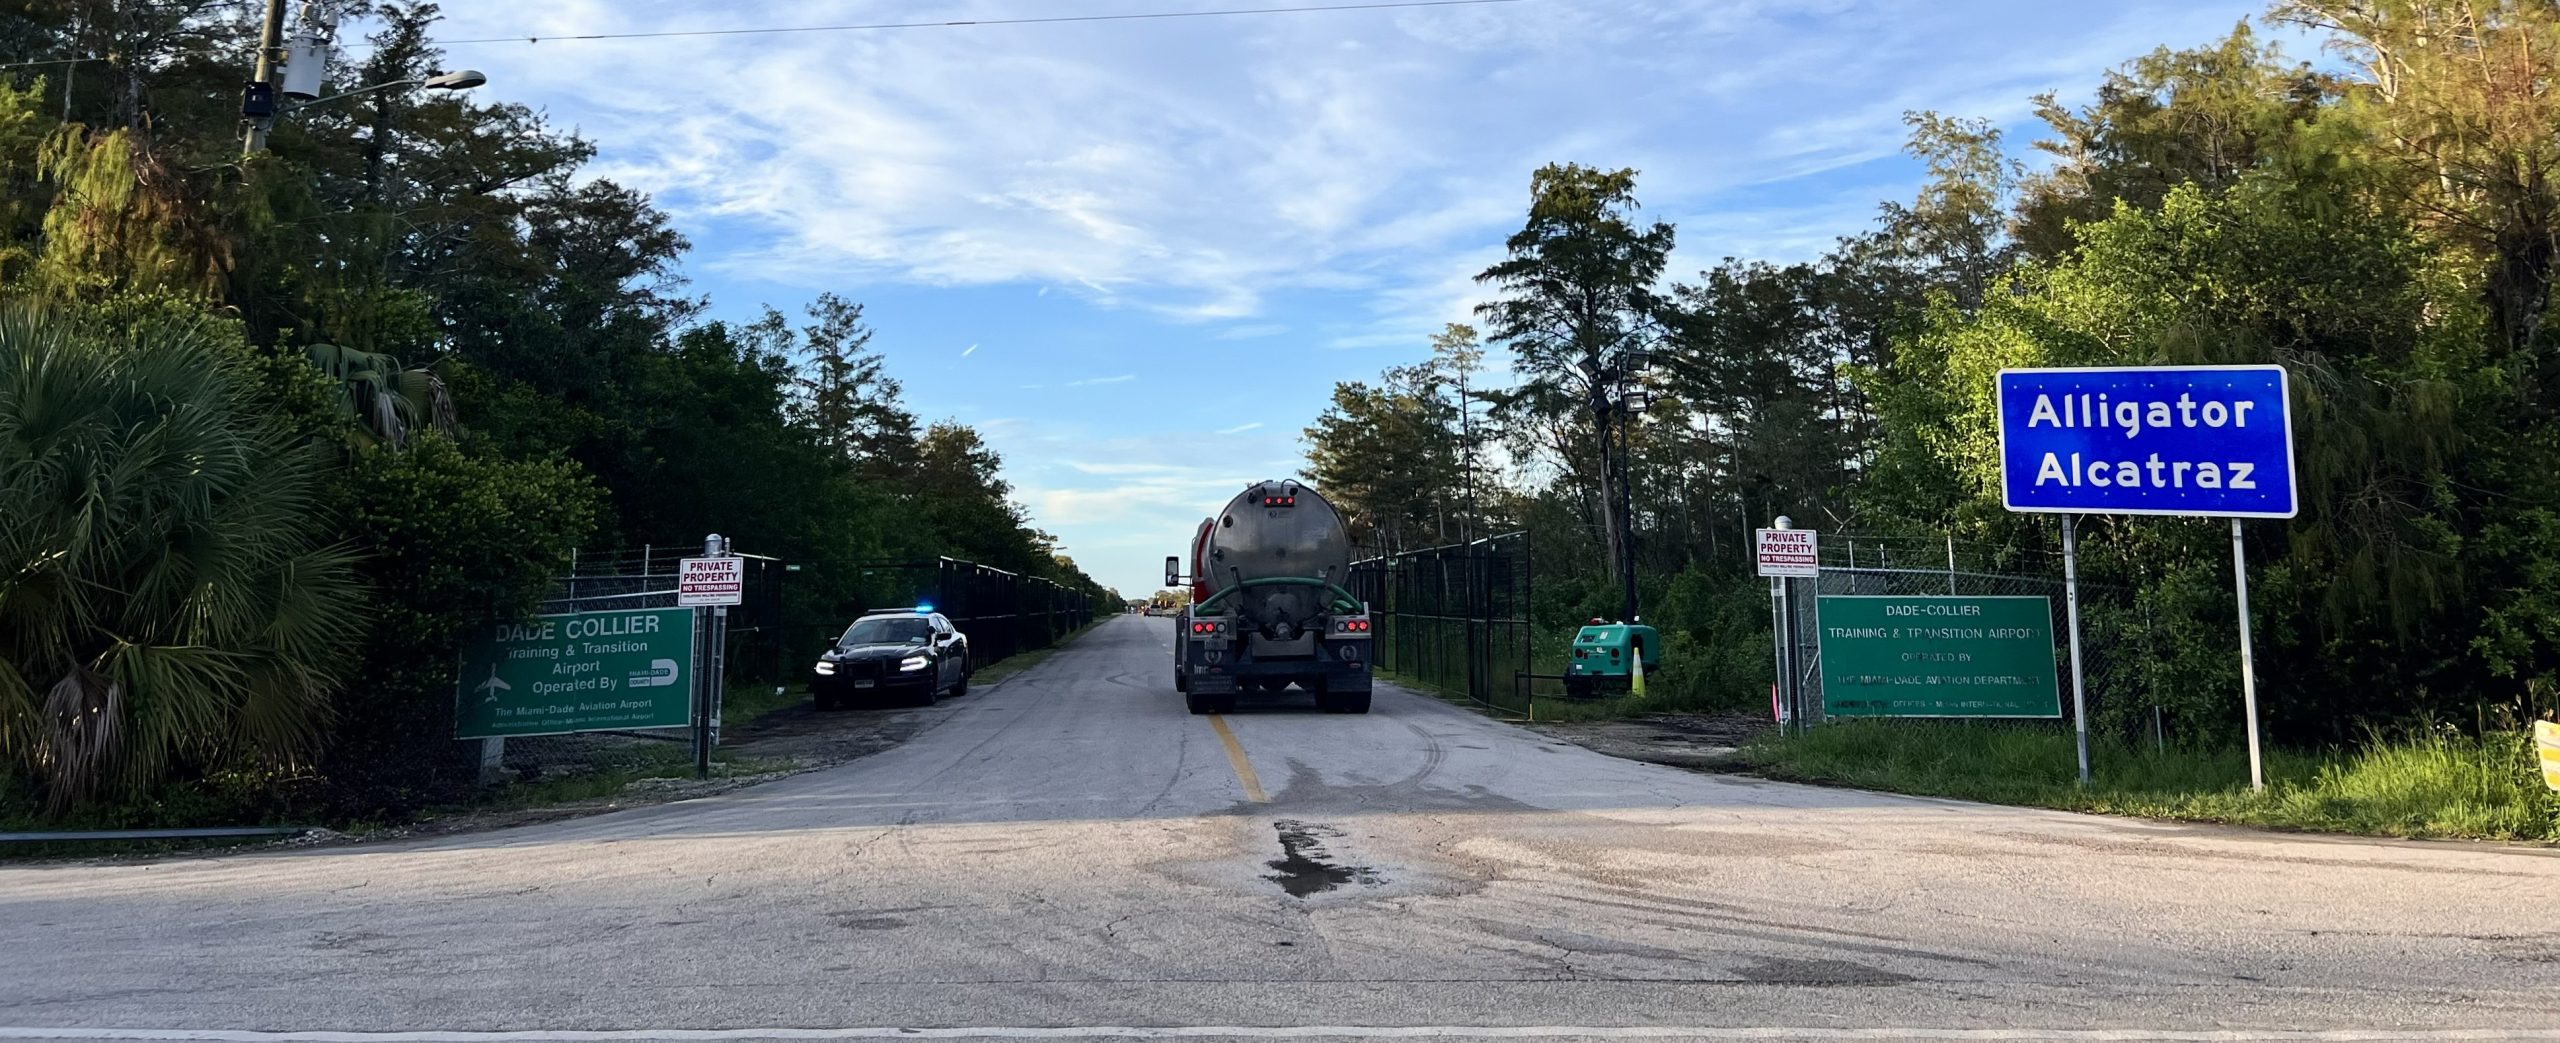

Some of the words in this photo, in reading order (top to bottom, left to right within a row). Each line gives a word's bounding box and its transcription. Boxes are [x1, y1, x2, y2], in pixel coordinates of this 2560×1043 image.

[2028, 392, 2254, 439] Alligator
[2035, 452, 2257, 489] Alcatraz
[1766, 533, 1807, 543] PRIVATE
[1761, 544, 1812, 553] PROPERTY
[690, 562, 733, 571] PRIVATE
[683, 572, 738, 582] PROPERTY
[1886, 605, 1981, 616] DADE-COLLIER
[496, 622, 555, 643] DADE
[566, 615, 660, 639] COLLIER
[1828, 627, 1887, 639] TRAINING
[1893, 628, 1901, 639] &
[505, 646, 559, 660] Training
[565, 645, 575, 656] &
[583, 640, 648, 655] Transition
[1959, 653, 1972, 662] BY
[552, 660, 601, 677] Airport
[533, 678, 596, 696] Operated
[600, 676, 618, 692] By
[516, 705, 575, 716] Miami-Dade
[579, 702, 616, 712] Aviation
[620, 699, 653, 710] Airport
